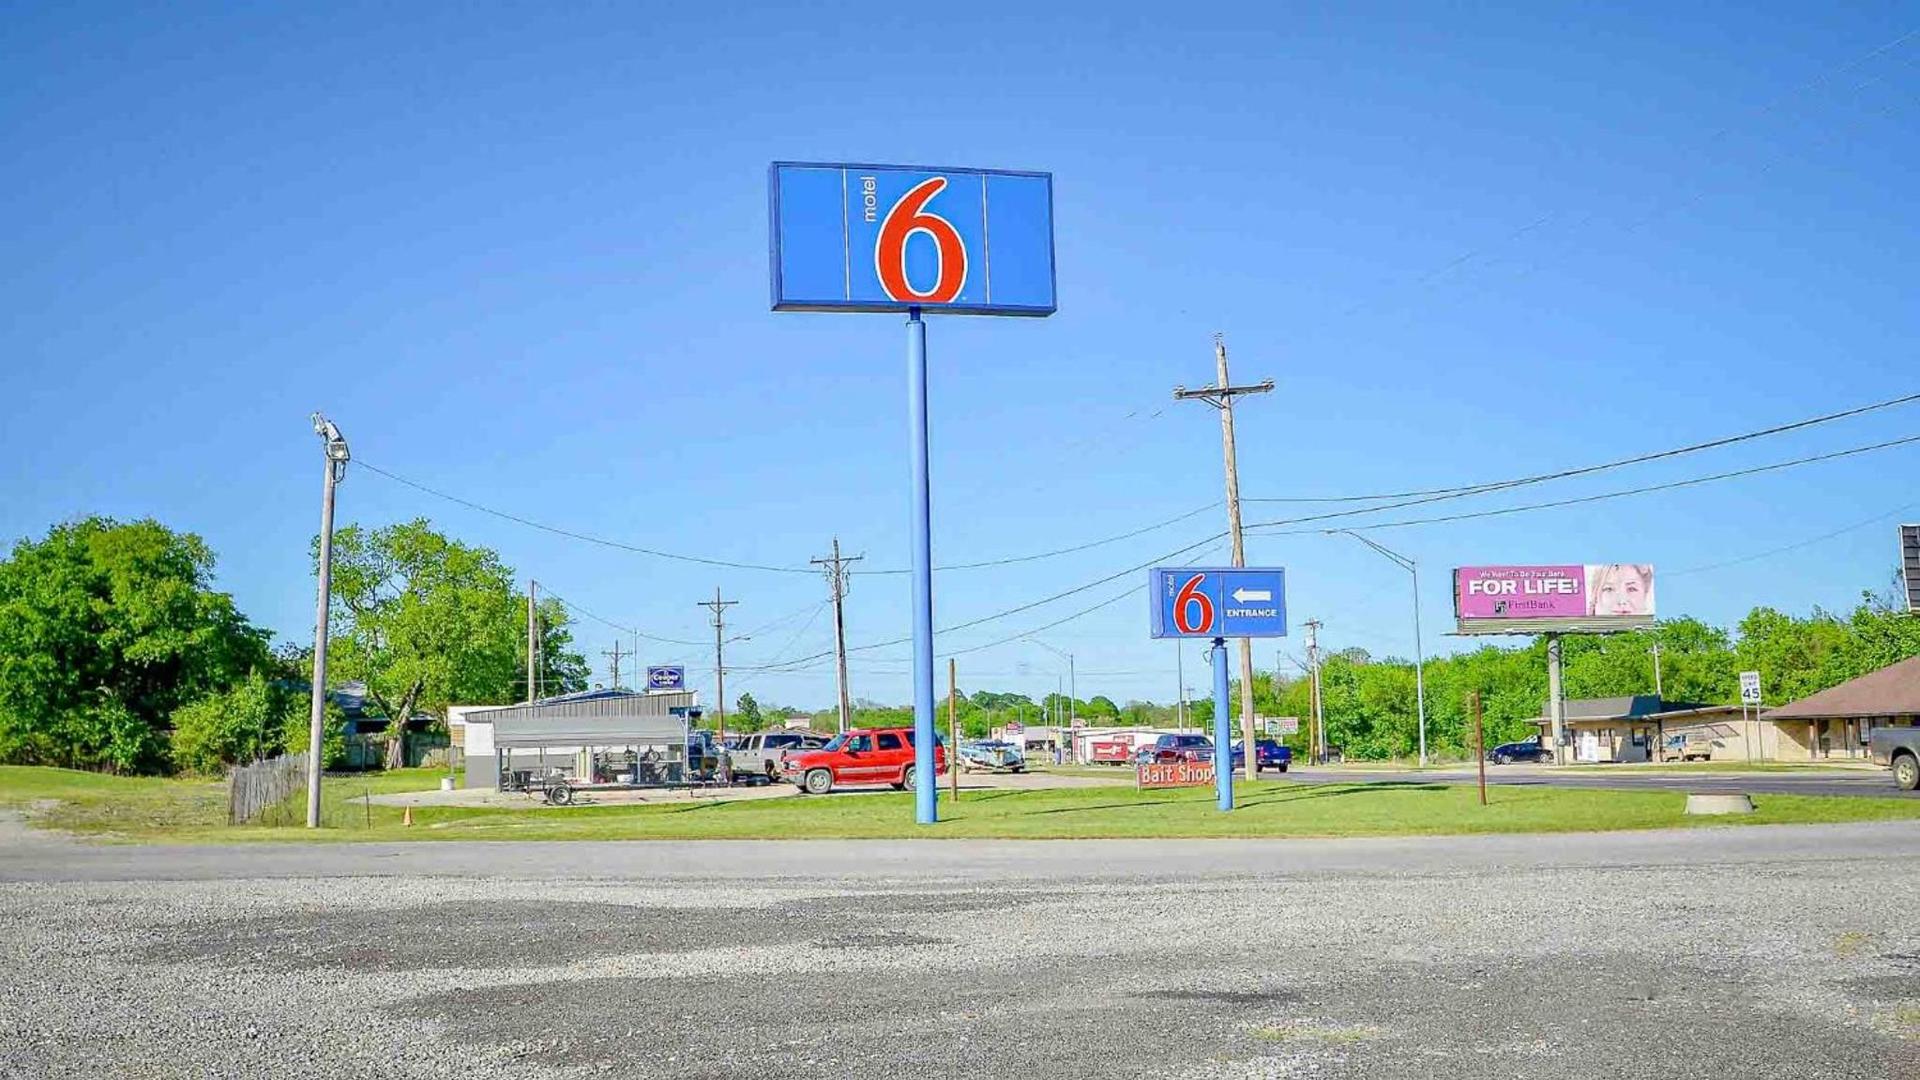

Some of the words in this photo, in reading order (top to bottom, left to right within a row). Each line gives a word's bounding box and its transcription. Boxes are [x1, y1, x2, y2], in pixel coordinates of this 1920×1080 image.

[861, 176, 877, 222] motel
[874, 176, 968, 303] 6
[1468, 580, 1518, 595] FOR
[1523, 578, 1578, 594] LIFE!
[1173, 573, 1214, 635] 6
[1226, 608, 1278, 617] ENTRANCE
[1743, 688, 1759, 699] 45
[1142, 766, 1173, 783] Bait
[1178, 764, 1213, 782] Shop
